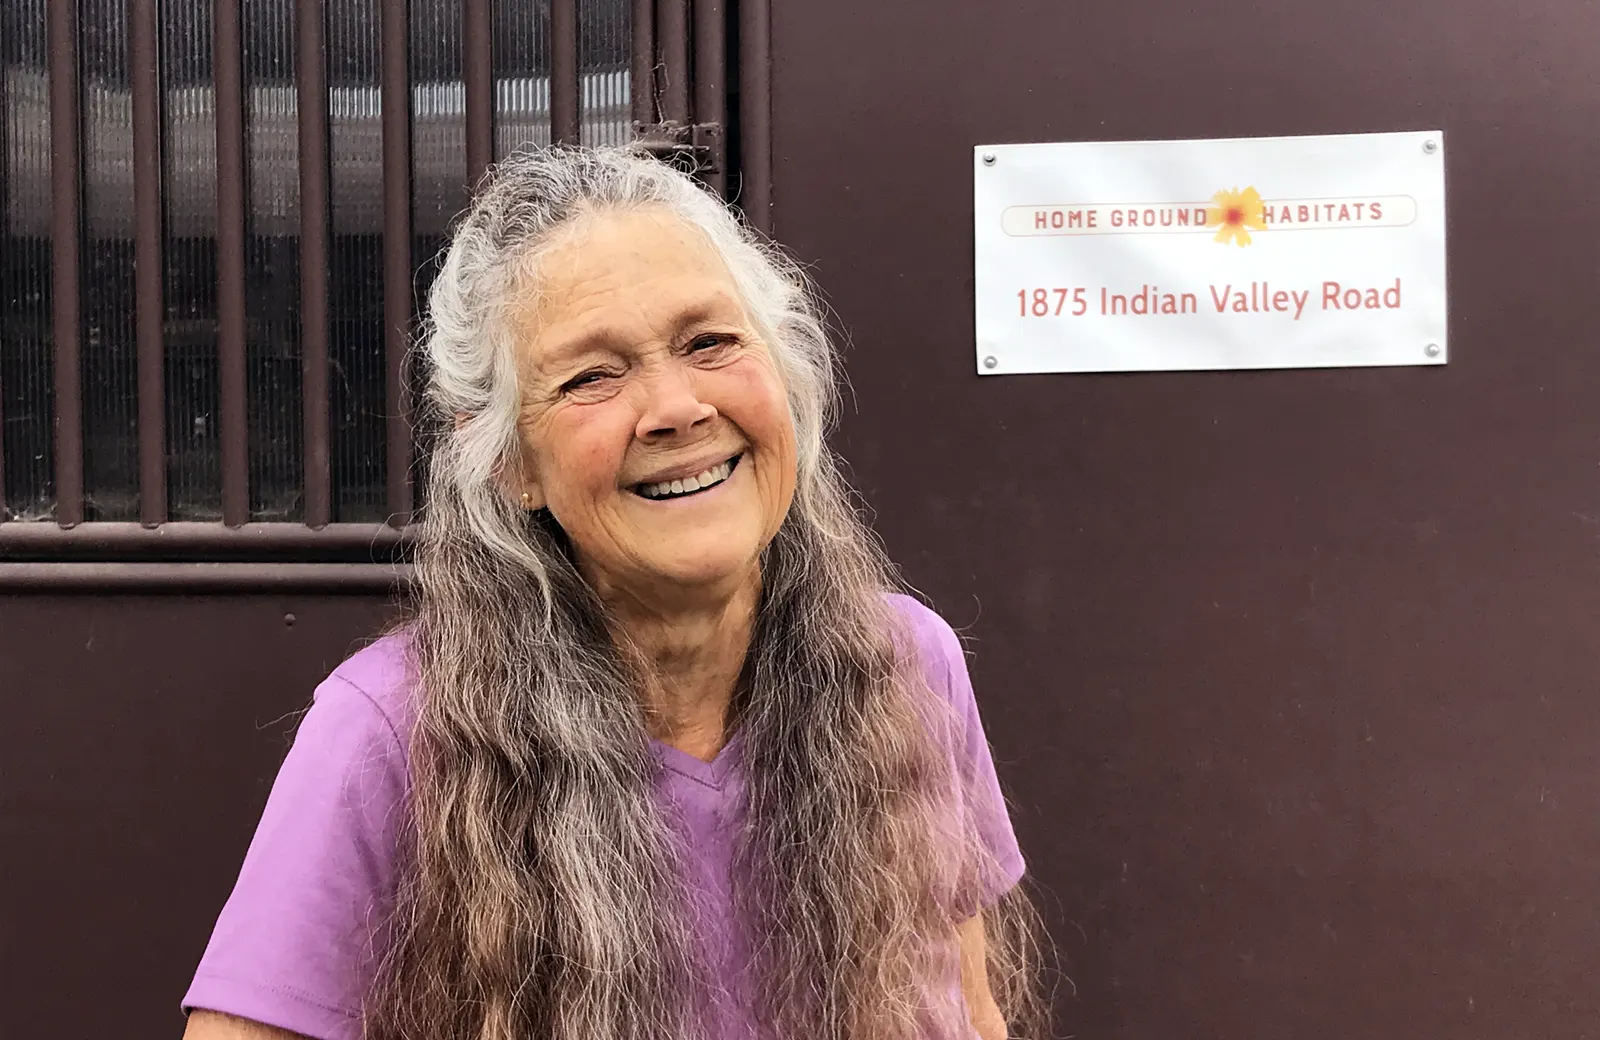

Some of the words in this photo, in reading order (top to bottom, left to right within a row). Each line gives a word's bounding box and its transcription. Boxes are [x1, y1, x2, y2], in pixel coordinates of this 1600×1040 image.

[1034, 210, 1097, 230] HOME
[1110, 208, 1208, 228] GROUND
[1262, 203, 1383, 225] HABITATS
[1017, 287, 1088, 317] 1875
[1100, 284, 1198, 316] Indian
[1209, 281, 1310, 321] Valley
[1321, 278, 1402, 311] Road
